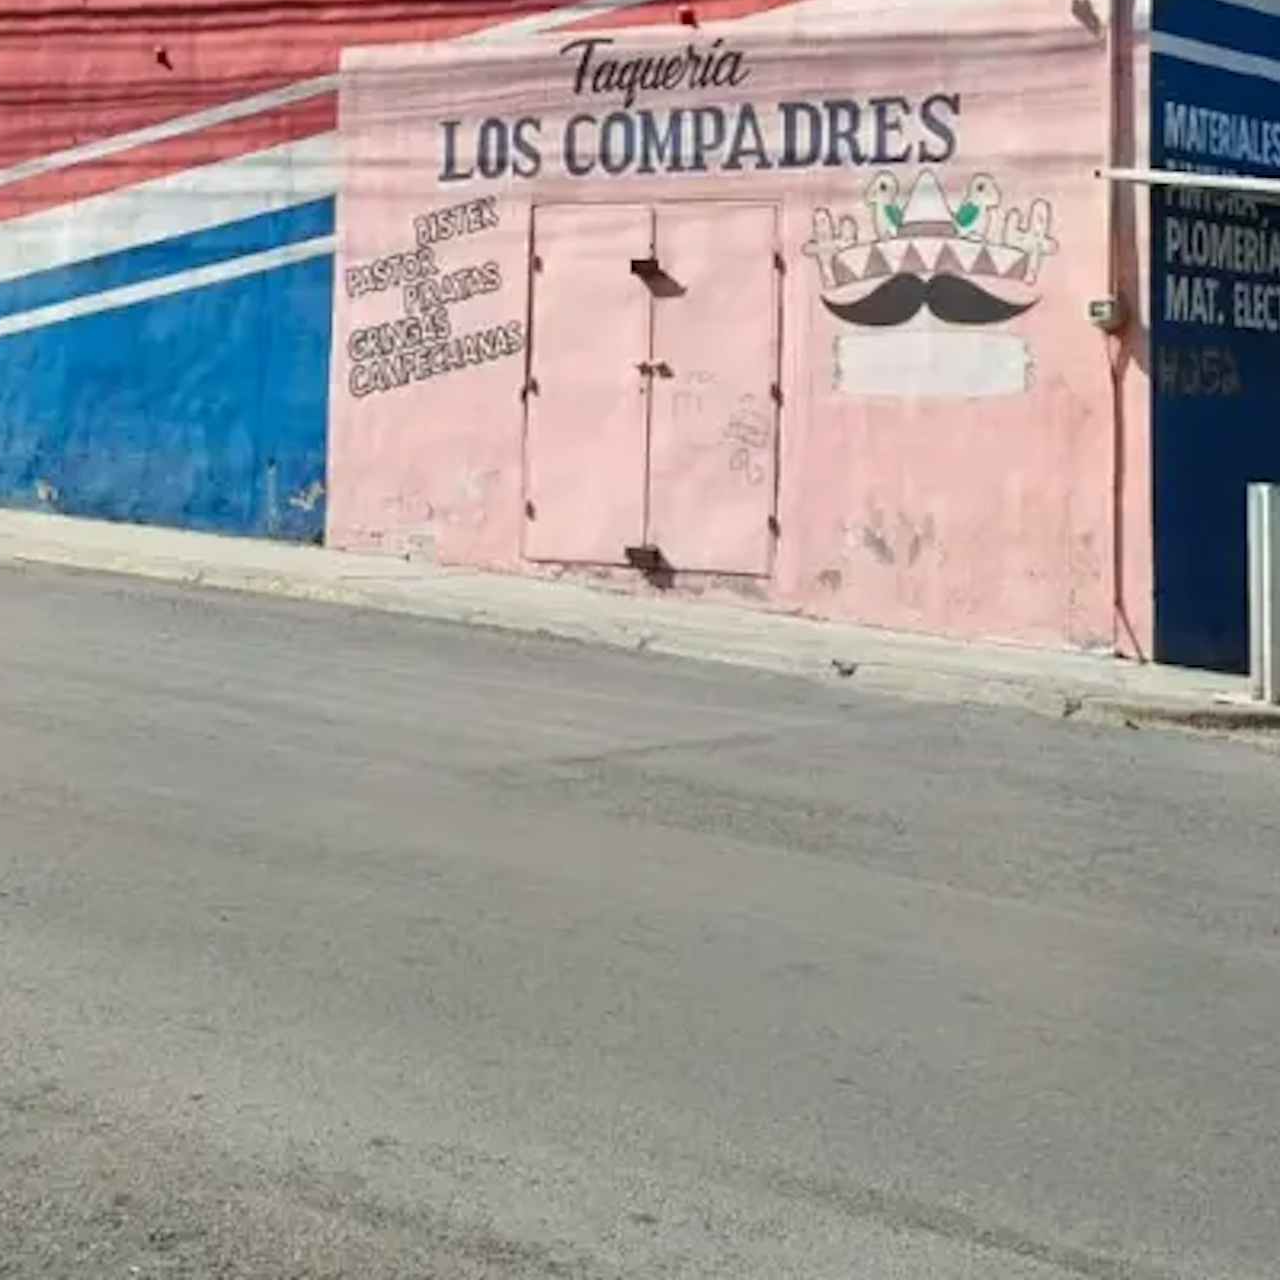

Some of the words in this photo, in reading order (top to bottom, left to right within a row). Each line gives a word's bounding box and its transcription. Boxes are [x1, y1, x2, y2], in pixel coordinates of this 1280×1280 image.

[559, 37, 751, 109] Taquería
[438, 118, 542, 182] LOS
[562, 93, 963, 177] COMPADRES
[344, 244, 440, 300] PASTOR
[402, 260, 502, 316] PIRATAS
[1164, 273, 1226, 326] MAT.
[348, 303, 451, 362] GRINGAS
